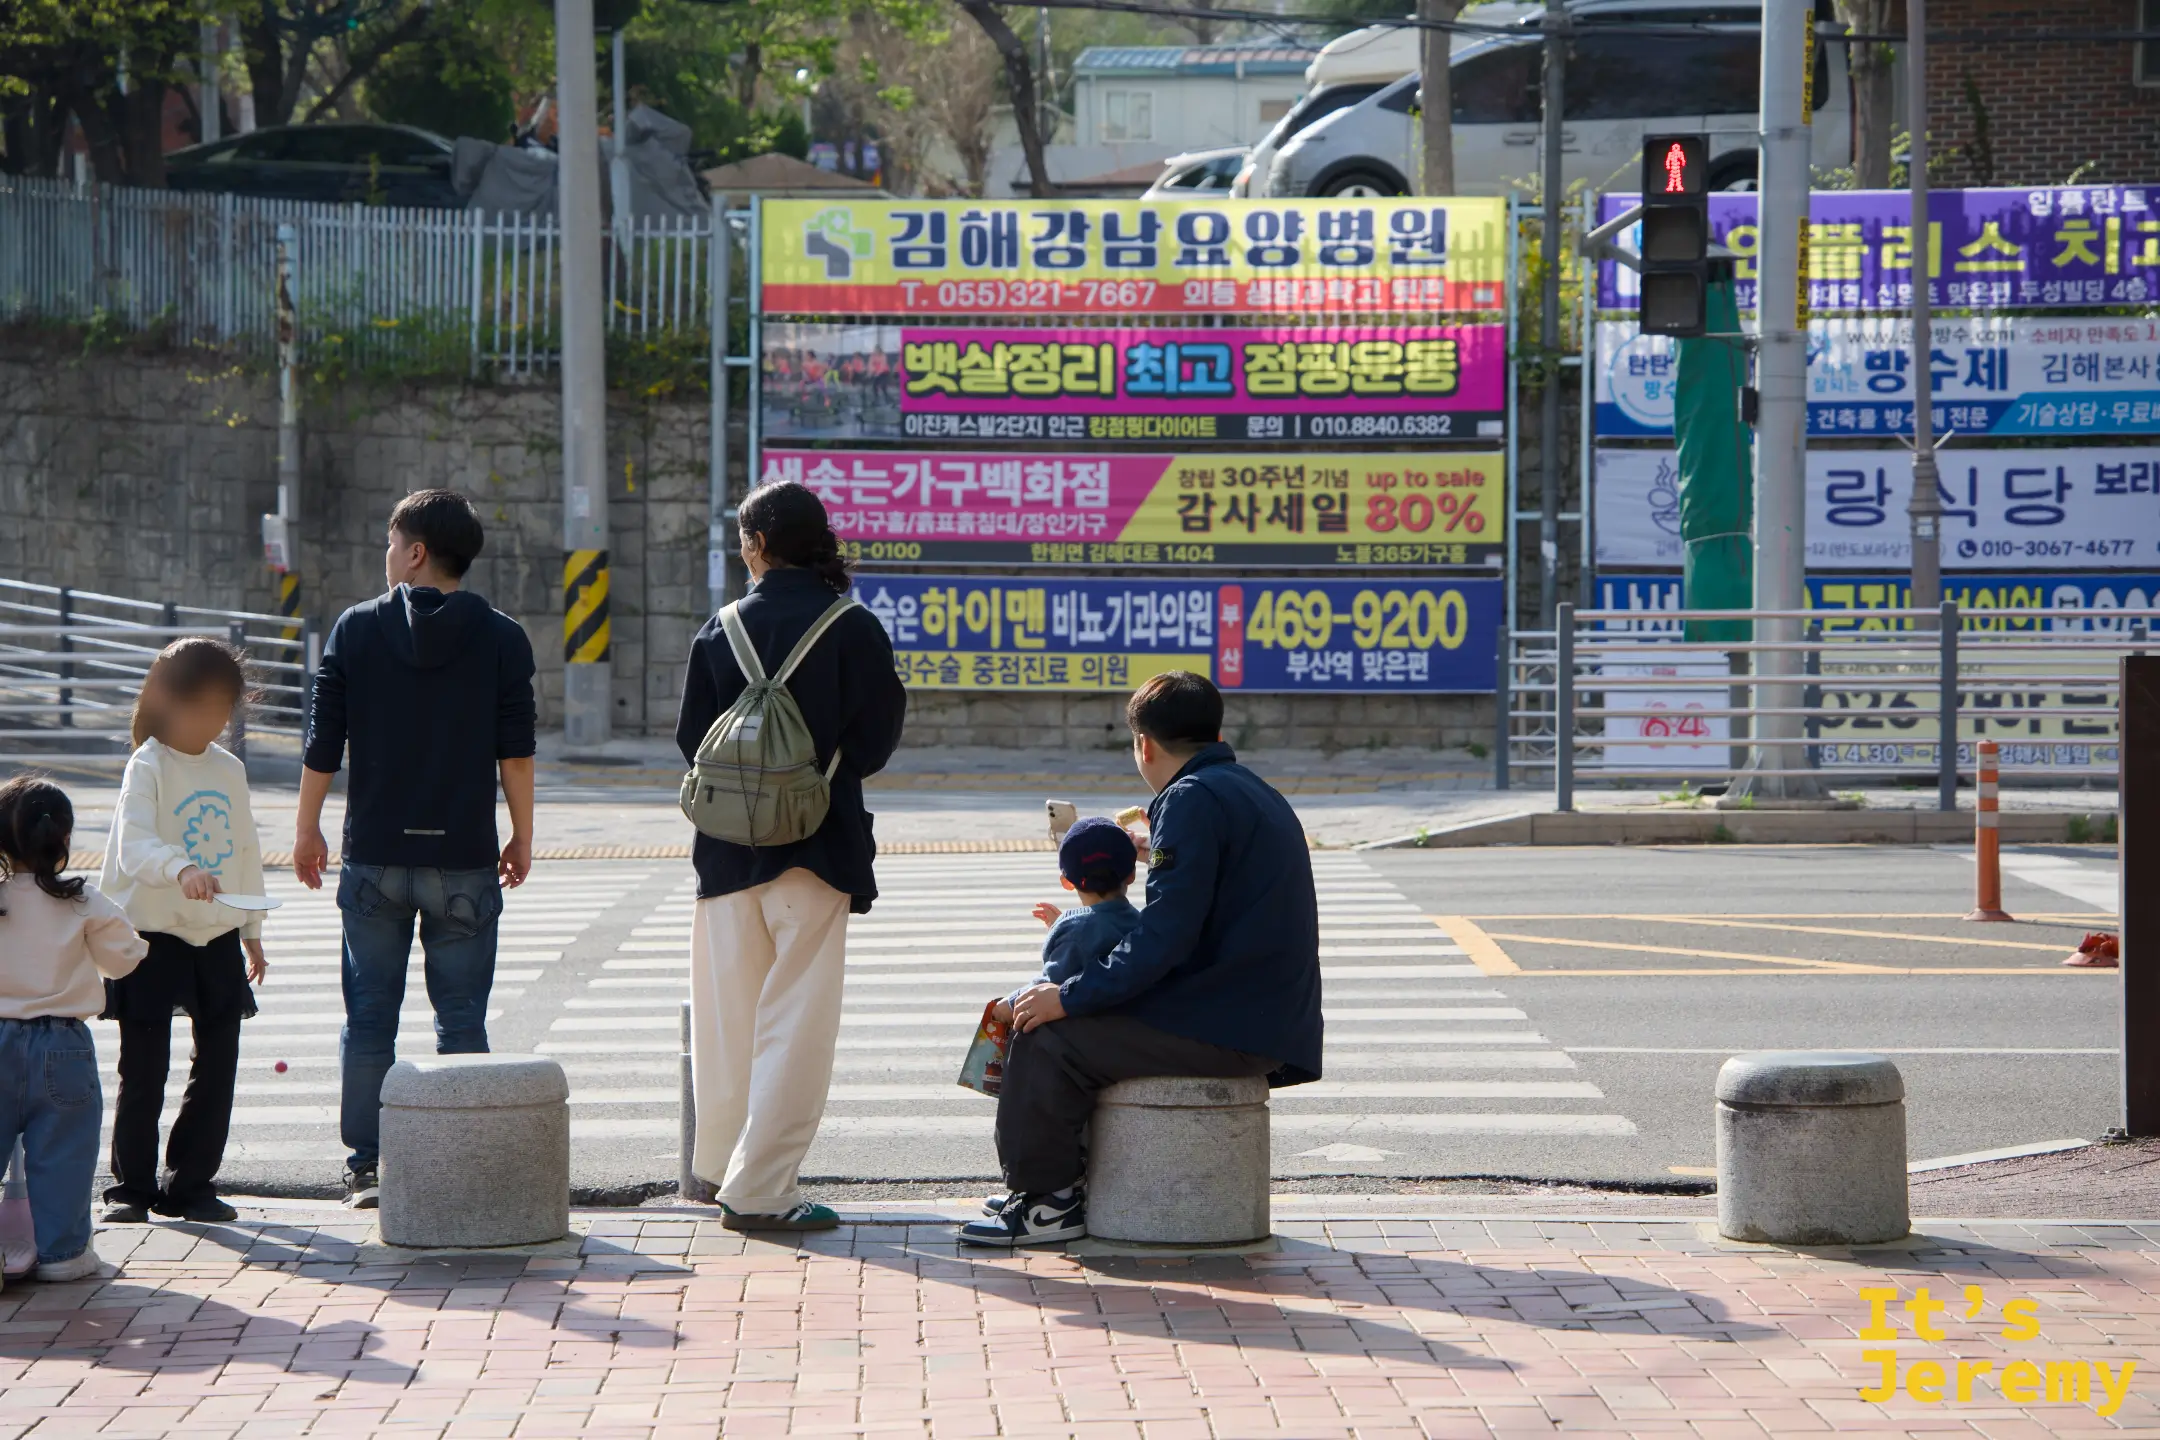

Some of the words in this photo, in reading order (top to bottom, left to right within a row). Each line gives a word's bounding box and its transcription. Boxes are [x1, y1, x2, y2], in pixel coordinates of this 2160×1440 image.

[889, 207, 1447, 269] 김해강남요양병원
[901, 283, 928, 306] T.
[938, 282, 1156, 307] 055)321-7667
[1183, 281, 1236, 306] 외동
[1948, 284, 2011, 308] 맞은편
[2020, 280, 2104, 303] 두성빌딩
[2111, 277, 2148, 301] 4층
[2032, 327, 2081, 344] 소비자
[2088, 325, 2139, 343] 만족도
[903, 341, 1116, 397] 뱃살정리
[1124, 341, 1235, 396] 최고
[1243, 339, 1459, 396] 점핑운동
[905, 415, 1043, 437] 이진캐스빌2단지
[1048, 415, 1085, 437] 인근
[1089, 415, 1217, 438] 킹점핑다이어트
[1247, 417, 1284, 438] 문의
[1311, 415, 1451, 437] 010.8840.6382
[1818, 408, 1877, 430] 건축물
[1950, 406, 1988, 429] 전문
[1179, 469, 1216, 489] 창립
[1222, 466, 1305, 489] 30주년
[1312, 468, 1349, 489] 기념
[1366, 470, 1398, 492] up
[1404, 469, 1429, 488] to
[1435, 468, 1485, 488] sale
[1178, 493, 1349, 533] 감사세일
[1365, 493, 1485, 534] 80%
[1031, 543, 1084, 562] 한림면
[1090, 543, 1160, 562] 김해대로
[1164, 544, 1215, 562] 1404
[1982, 539, 2135, 557] 010-3067-4677
[1052, 589, 1214, 648] 비뇨기과의원
[1246, 589, 1468, 650] 469-9200
[971, 653, 1070, 686] 중점진료
[1080, 653, 1129, 686] 의원
[1285, 651, 1354, 682] 부산역
[1361, 651, 1430, 682] 맞은편
